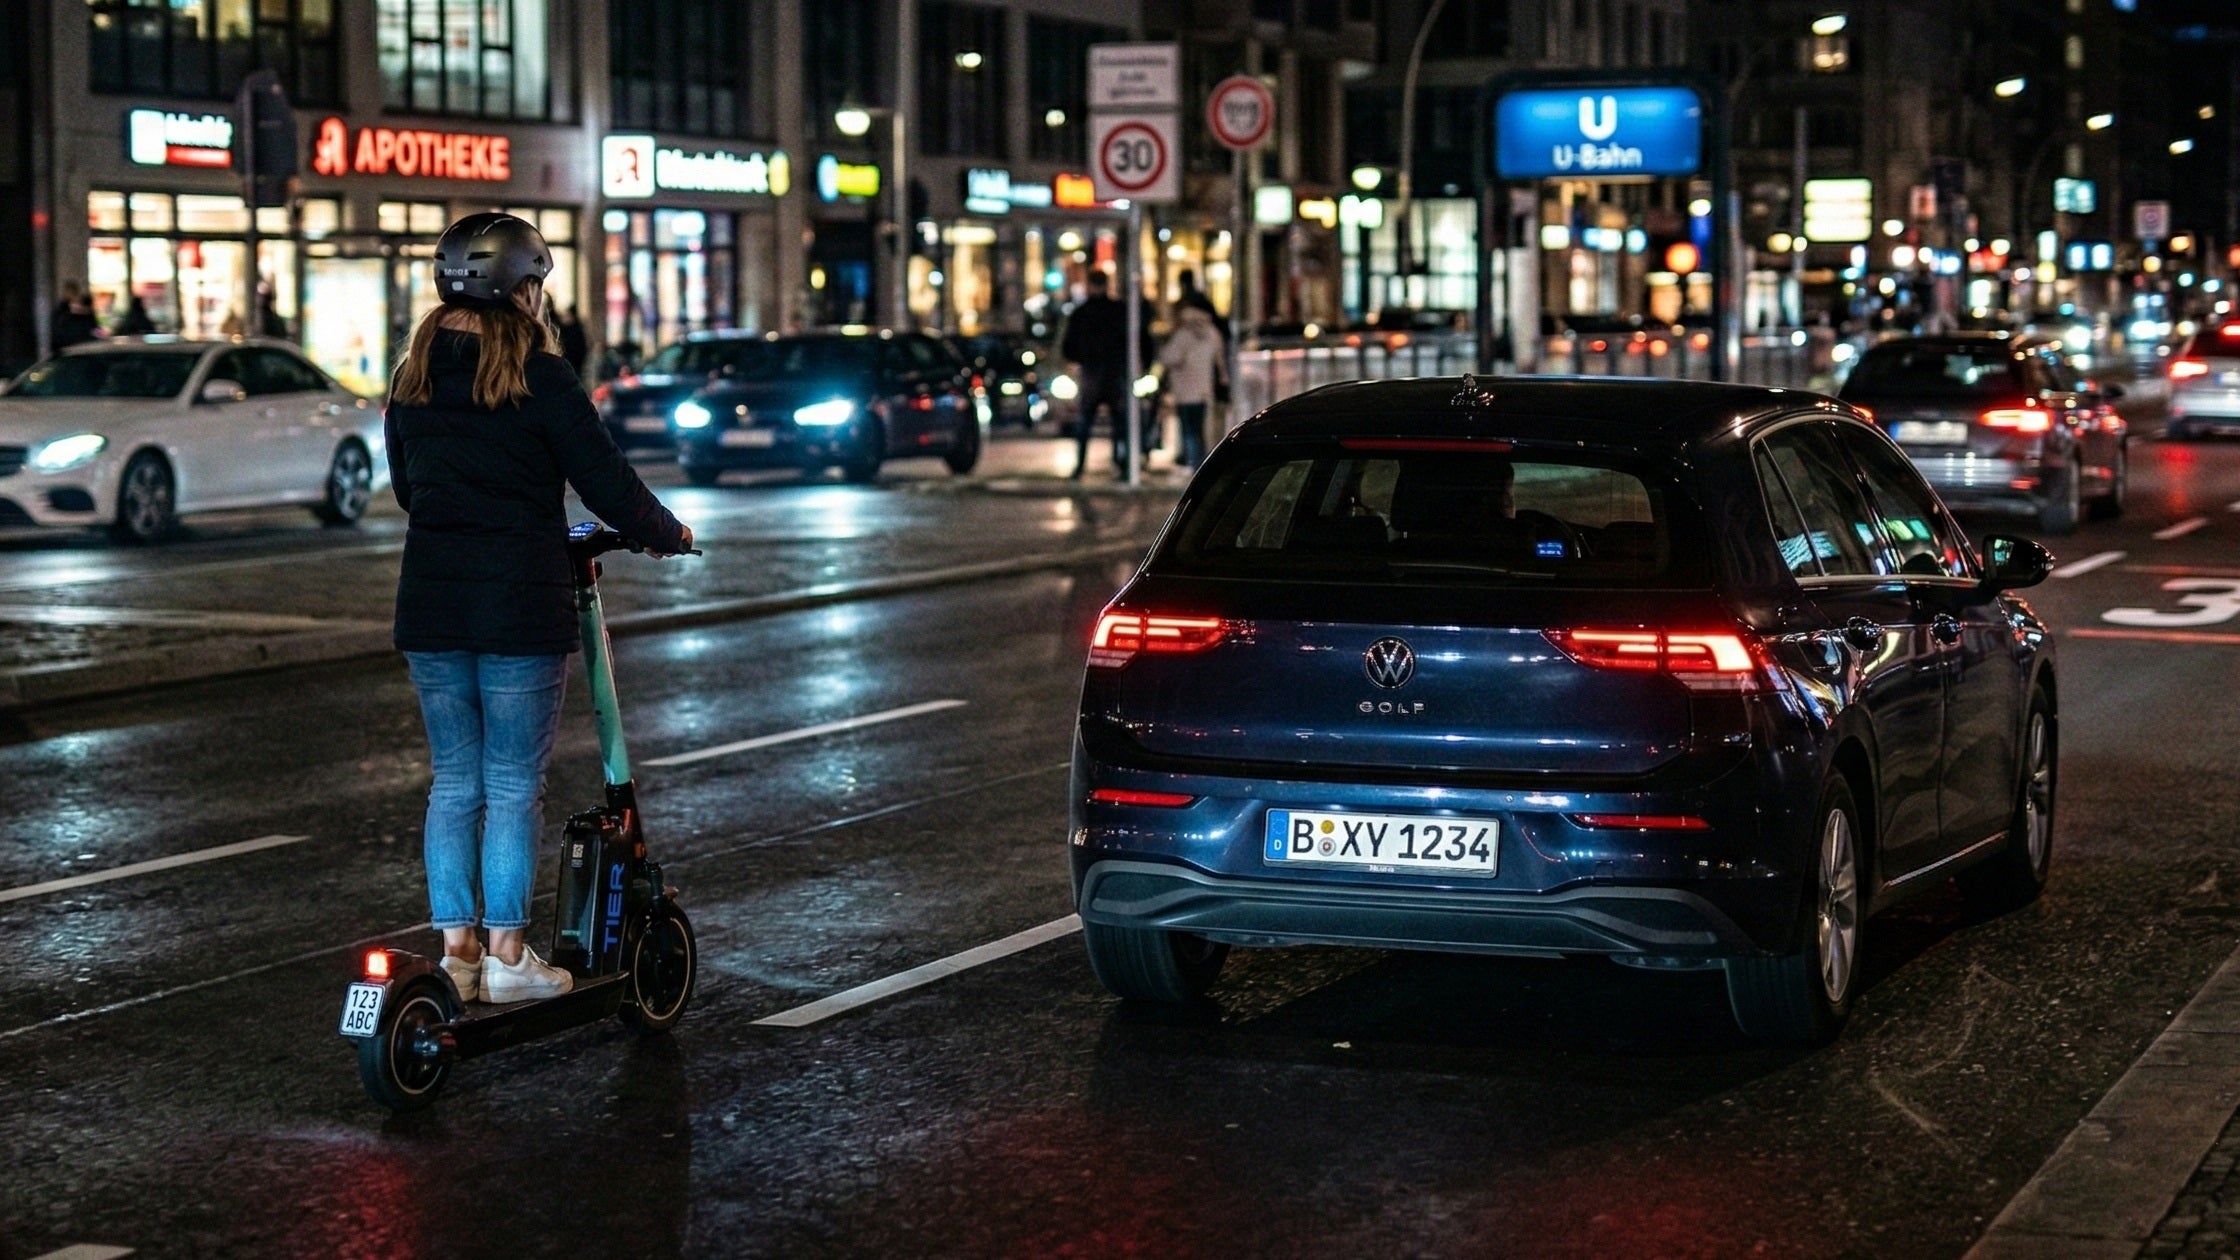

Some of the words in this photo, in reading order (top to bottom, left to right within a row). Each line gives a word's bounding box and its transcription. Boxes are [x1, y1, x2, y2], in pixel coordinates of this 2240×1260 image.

[1578, 95, 1617, 141] U
[354, 127, 511, 181] APOTHEKE
[1112, 139, 1153, 172] 30
[1552, 142, 1643, 170] U-Bahn
[1359, 701, 1425, 714] GOLF
[1273, 839, 1282, 850] D
[1292, 818, 1314, 853] B
[1340, 820, 1388, 857] XY
[1398, 823, 1490, 863] 1234
[603, 862, 625, 953] TIER
[352, 989, 378, 1009] 123
[346, 1010, 374, 1030] ABC
